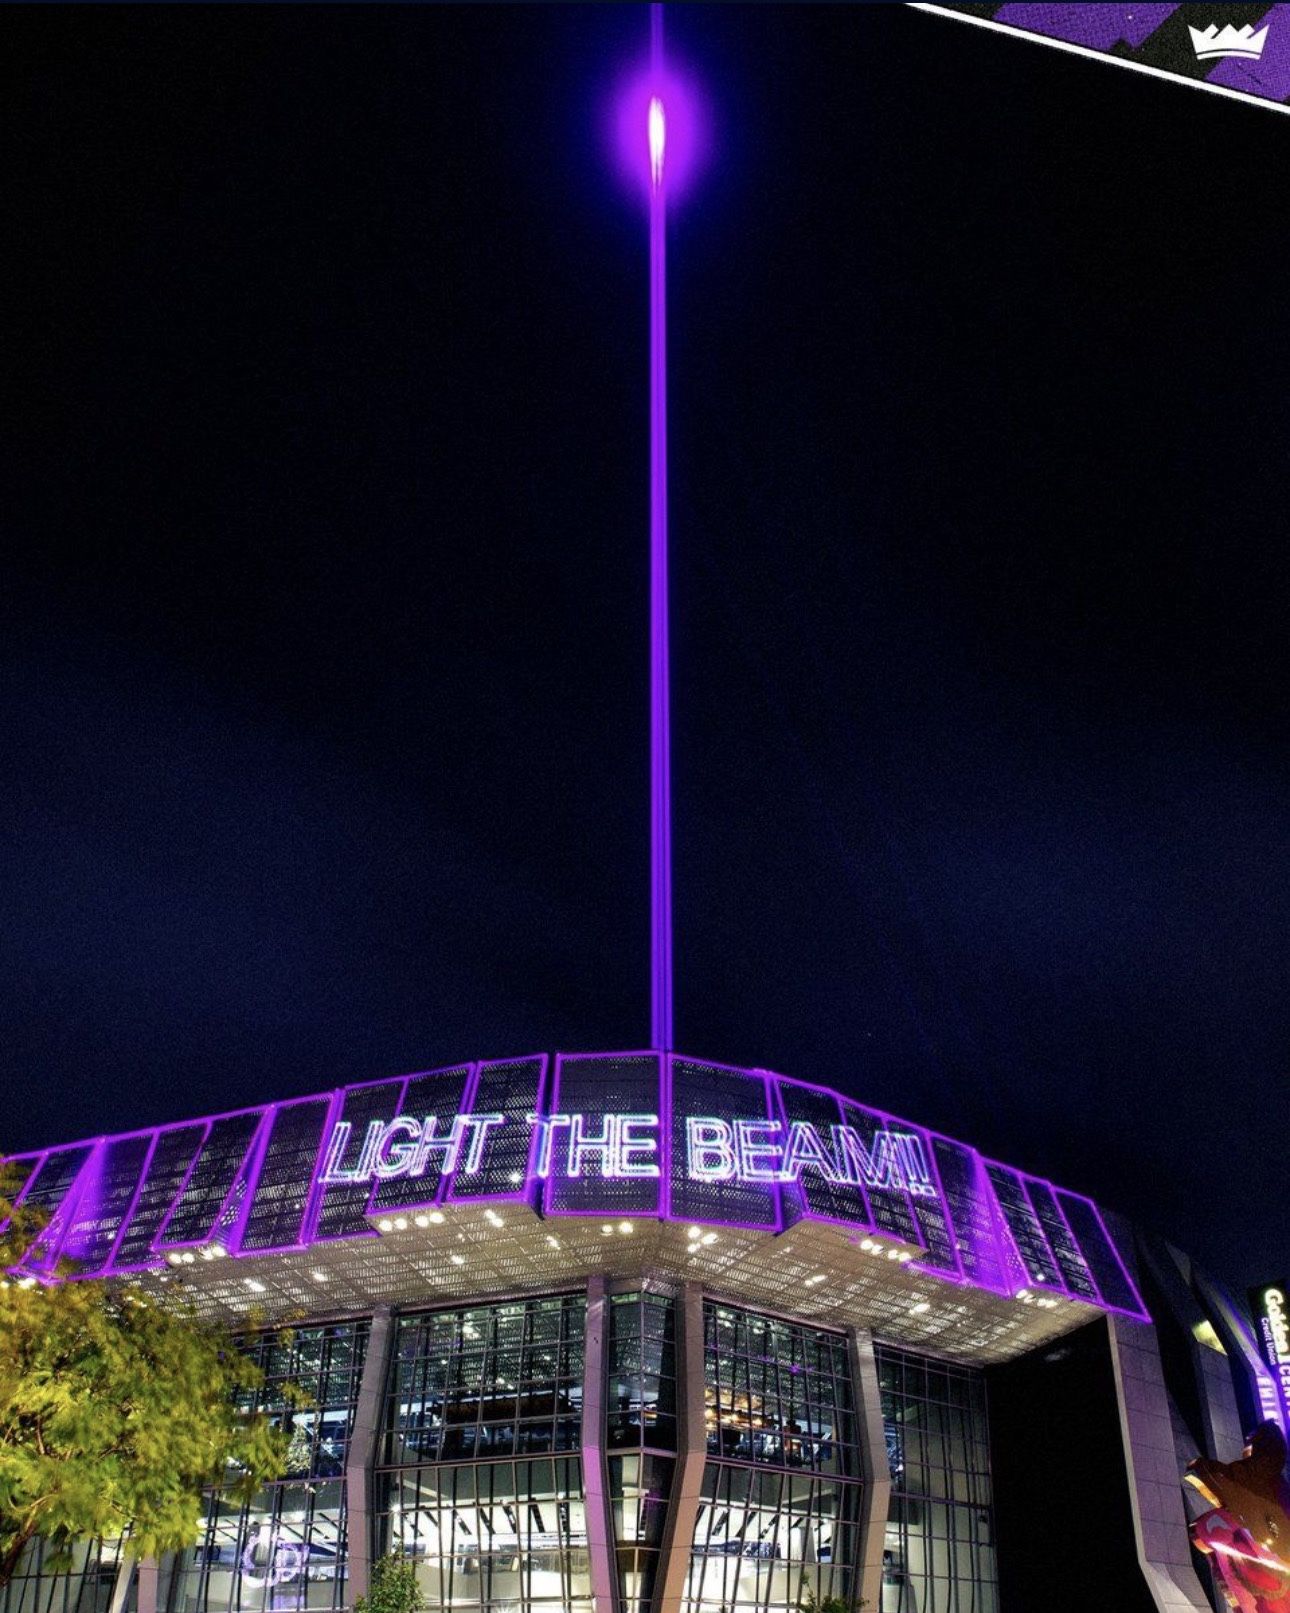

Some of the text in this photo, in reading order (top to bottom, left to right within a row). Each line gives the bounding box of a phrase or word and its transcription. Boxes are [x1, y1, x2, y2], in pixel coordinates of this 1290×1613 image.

[318, 1113, 937, 1197] LIGHT THE BEAM!!
[1261, 1317, 1272, 1341] Credit
[1264, 1288, 1289, 1353] Golden
[1266, 1342, 1277, 1366] Union
